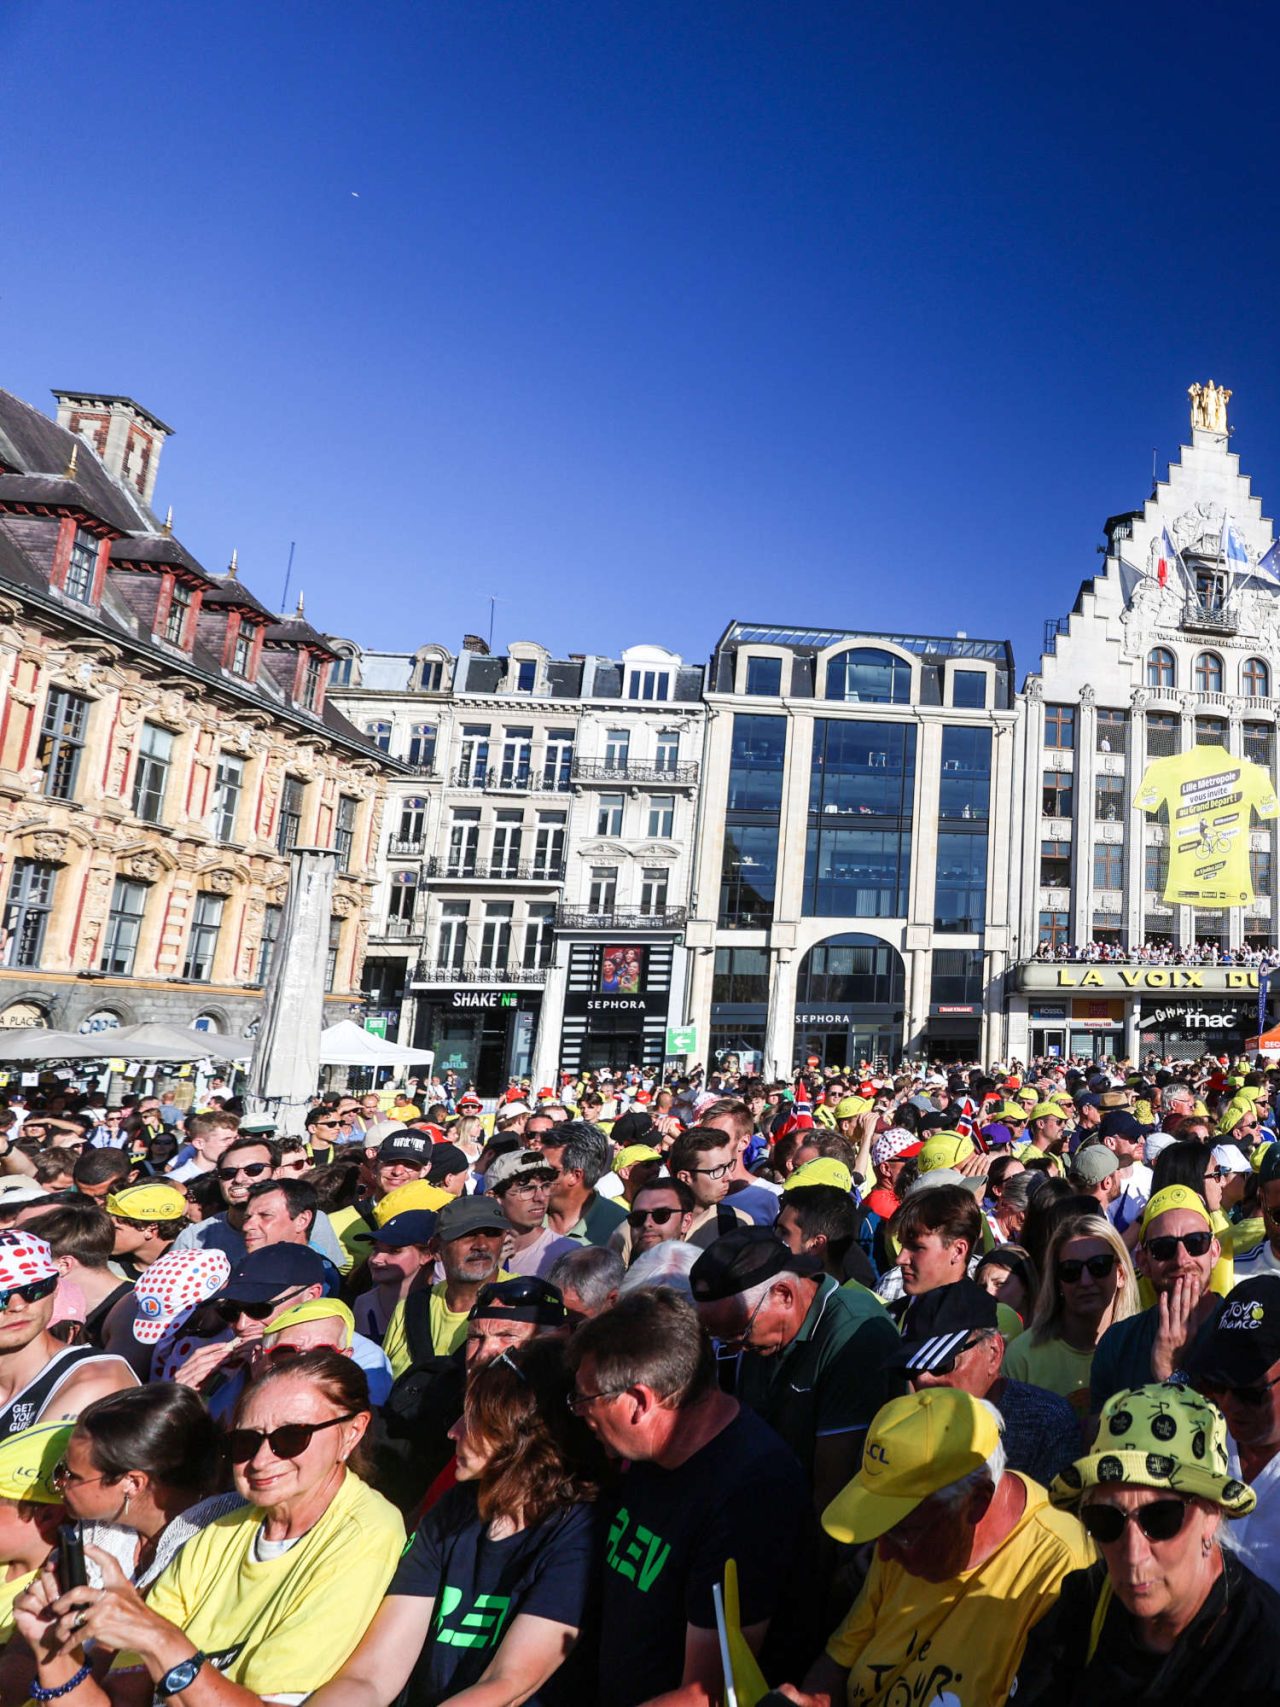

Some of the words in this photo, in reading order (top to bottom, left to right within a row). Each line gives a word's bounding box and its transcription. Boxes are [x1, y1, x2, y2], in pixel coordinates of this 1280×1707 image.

[1181, 782, 1198, 794] Lille
[1189, 793, 1207, 804] vous
[1207, 786, 1228, 799] invite
[1058, 969, 1105, 987] LA
[1119, 970, 1205, 988] VOIX
[1226, 971, 1260, 989] DU
[587, 1000, 646, 1010] SEPHORA
[795, 1014, 850, 1024] SEPHORA
[1184, 1012, 1237, 1028] fnac
[12, 1402, 35, 1414] GET
[17, 1466, 44, 1480] LCL
[906, 1630, 931, 1662] le
